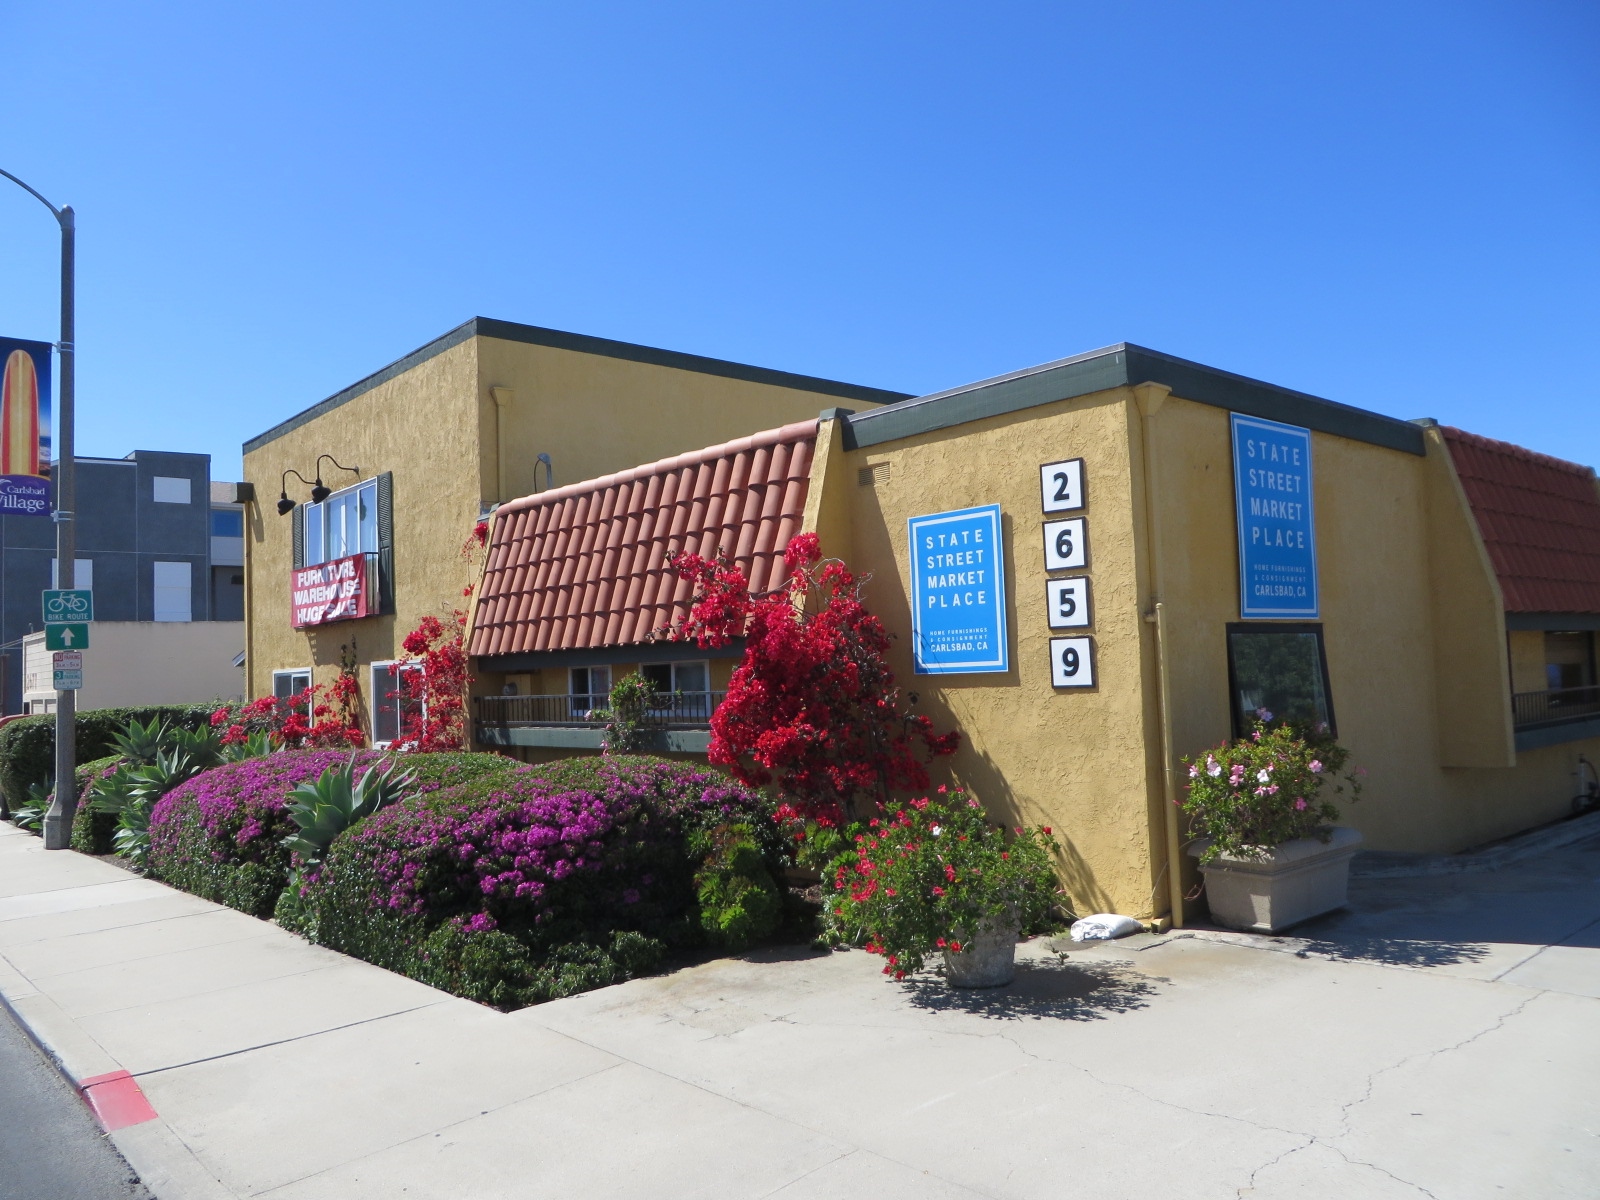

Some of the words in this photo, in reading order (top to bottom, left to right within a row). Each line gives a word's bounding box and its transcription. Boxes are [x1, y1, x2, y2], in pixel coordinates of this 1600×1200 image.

[1247, 439, 1301, 466] STATE
[7, 485, 46, 495] Carlsbad
[1053, 472, 1070, 501] 2
[1249, 468, 1301, 493] STREET
[1251, 497, 1302, 521] MARKET
[926, 529, 983, 549] STATE
[1055, 529, 1073, 558] 6
[1252, 526, 1304, 549] PLACE
[927, 549, 984, 569] STREET
[1271, 565, 1306, 573] FURNISHINGS
[297, 560, 356, 587] FURNITURE
[928, 570, 985, 589] MARKET
[1261, 574, 1306, 582] CONSIGNMENT
[294, 578, 361, 606] WAREHOUSE
[928, 590, 986, 608] PLACE
[1255, 584, 1296, 598] CARLSBAD,
[1297, 586, 1306, 597] CA
[297, 605, 326, 624] HUGE
[325, 598, 357, 619] SALE
[1059, 588, 1076, 617] 5
[48, 613, 64, 621] BIKE
[67, 612, 89, 620] ROUTE
[931, 642, 975, 652] CARLSBAD,
[977, 641, 988, 650] CA
[937, 634, 988, 642] CONSIGNMENT
[1062, 647, 1080, 677] 9
